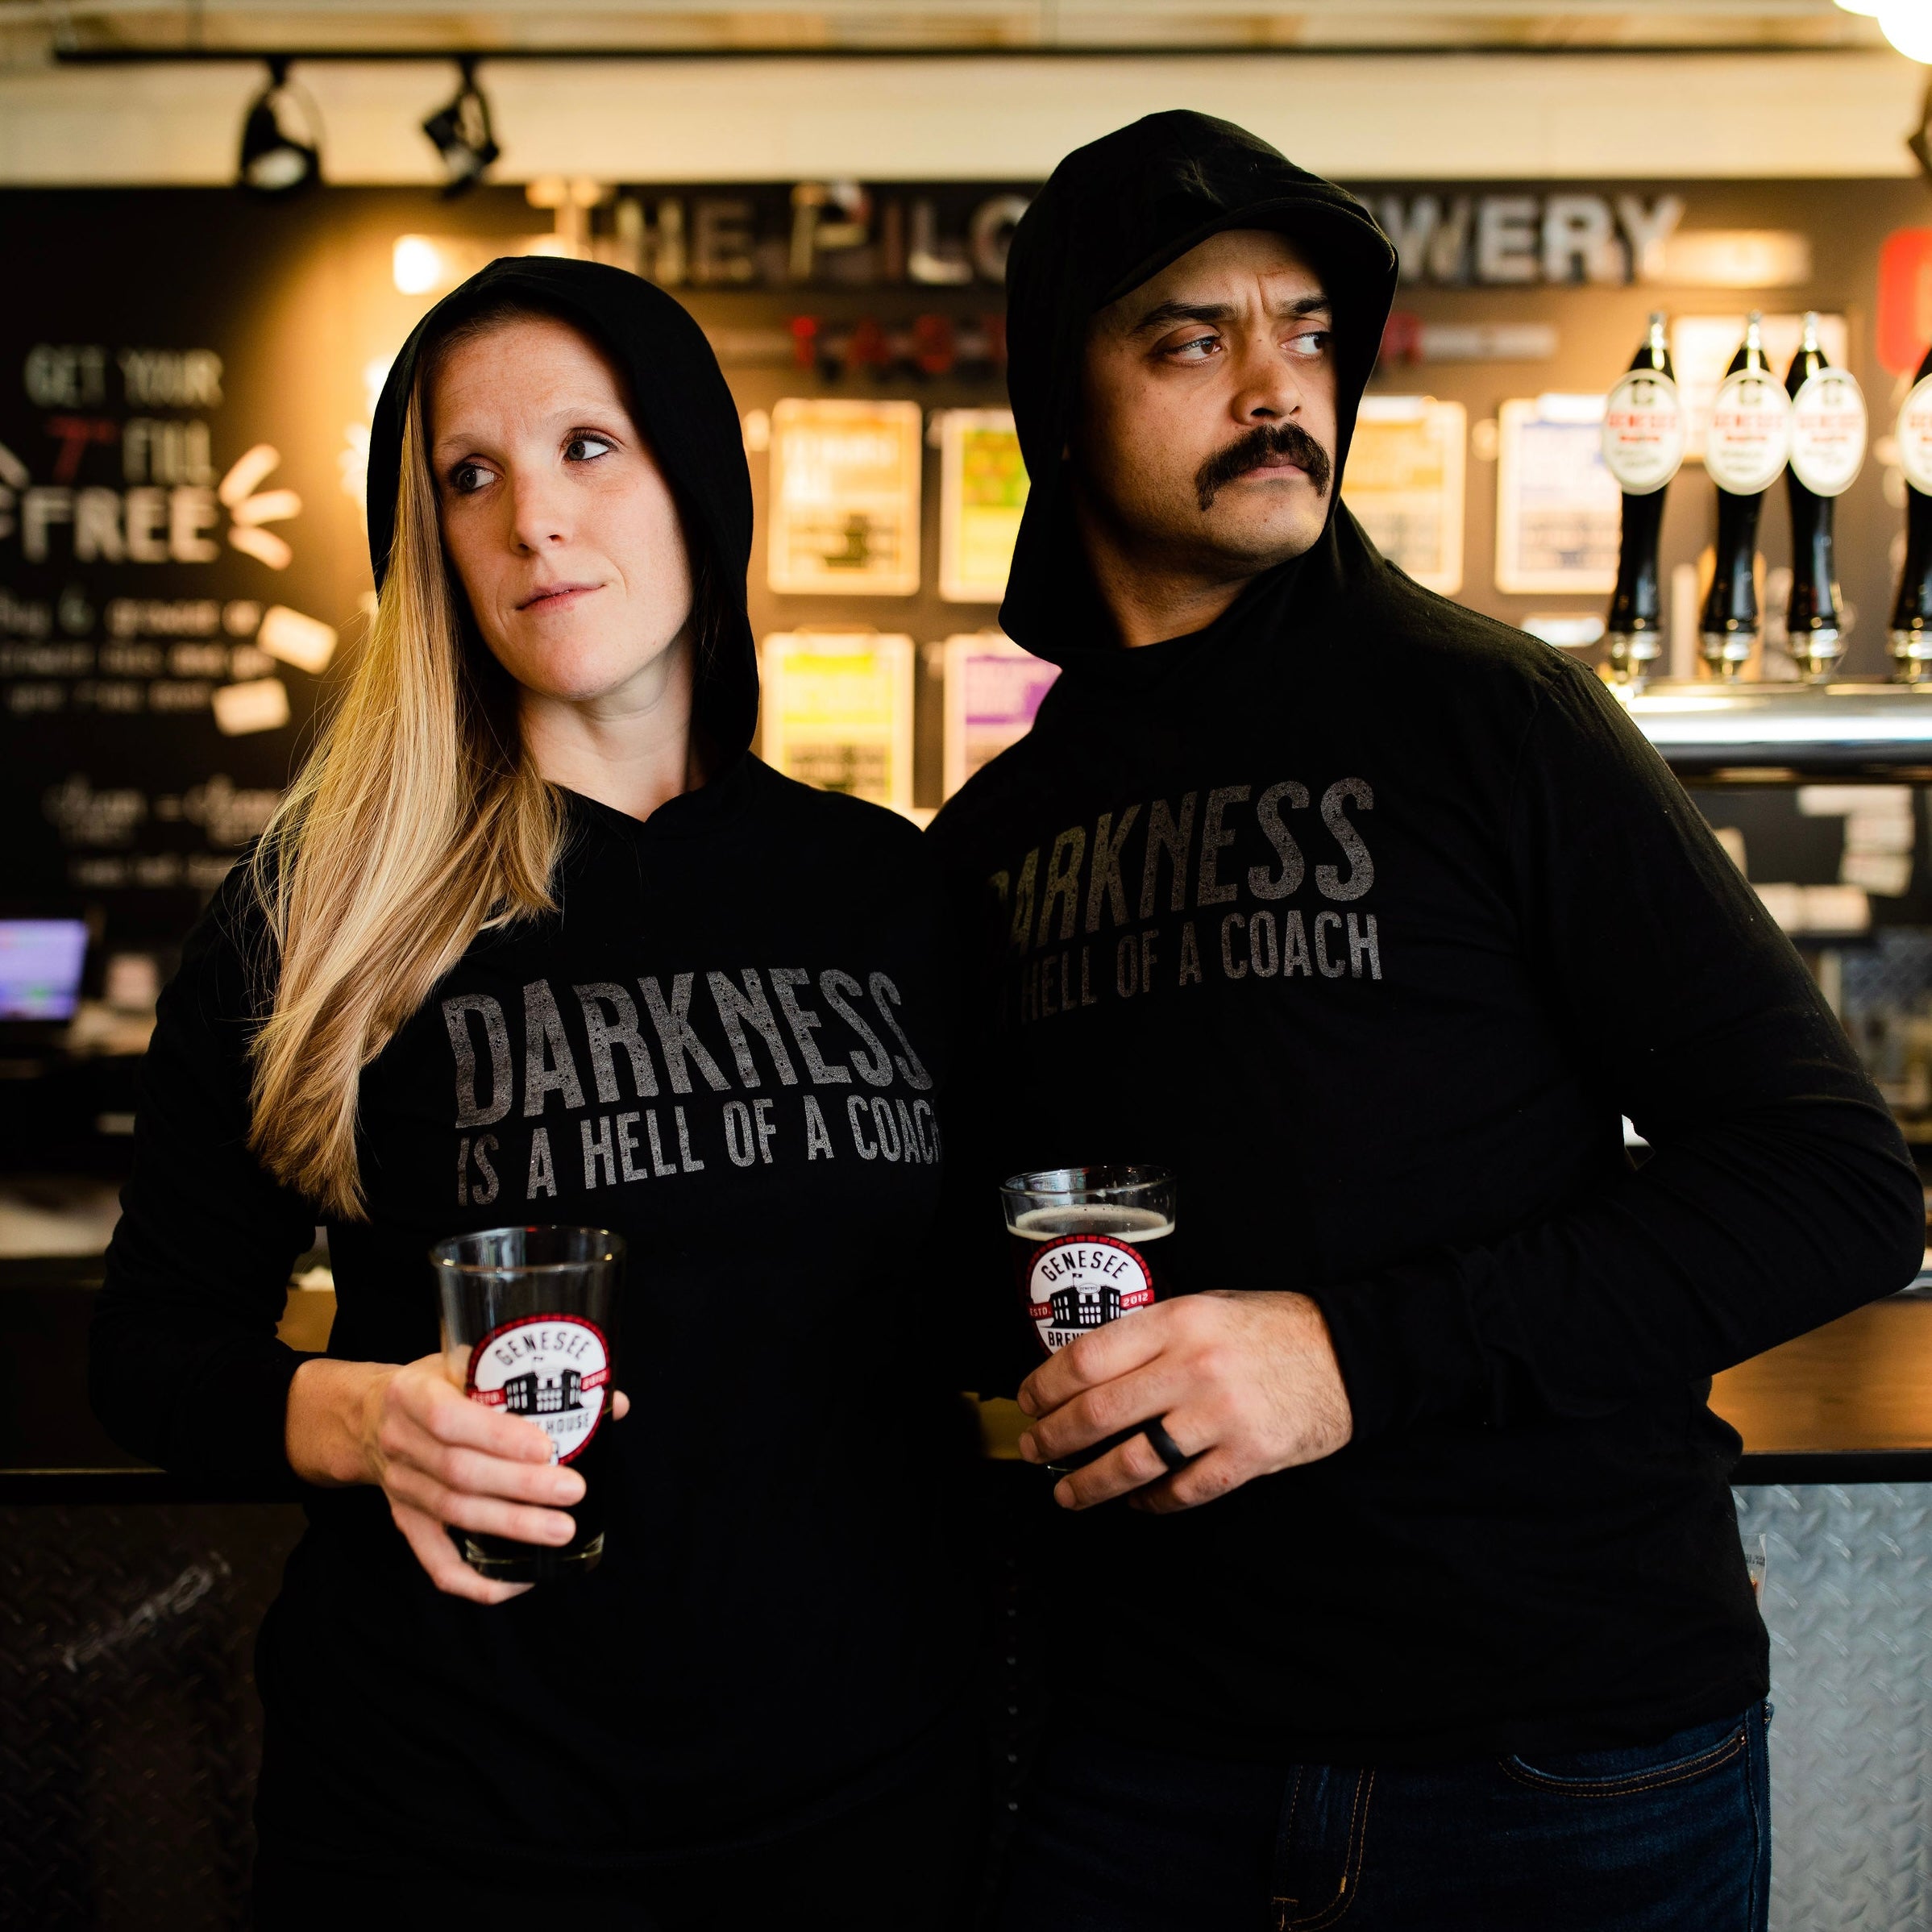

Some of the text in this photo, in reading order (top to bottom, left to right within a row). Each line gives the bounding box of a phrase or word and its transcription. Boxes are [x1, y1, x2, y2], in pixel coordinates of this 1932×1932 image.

[526, 182, 754, 280] THE
[1364, 196, 1683, 282] WERY
[24, 344, 224, 407] GET YOUR
[123, 418, 213, 484] FILL
[20, 485, 219, 564] FREE
[1020, 945, 1097, 1026] HELL
[1116, 929, 1160, 999] OF
[1178, 920, 1203, 987] A
[1220, 909, 1382, 980] COACH
[441, 967, 933, 1129] DARKNESS
[457, 1133, 500, 1207] IS
[526, 1128, 558, 1200] A
[580, 1106, 705, 1190] HELL
[723, 1098, 777, 1168] OF
[803, 1095, 835, 1161] A
[1041, 1250, 1128, 1282] GENESEE
[1122, 1292, 1149, 1307] 2012
[494, 1331, 591, 1366] GENESEE
[546, 1412, 589, 1435] HOUSE
